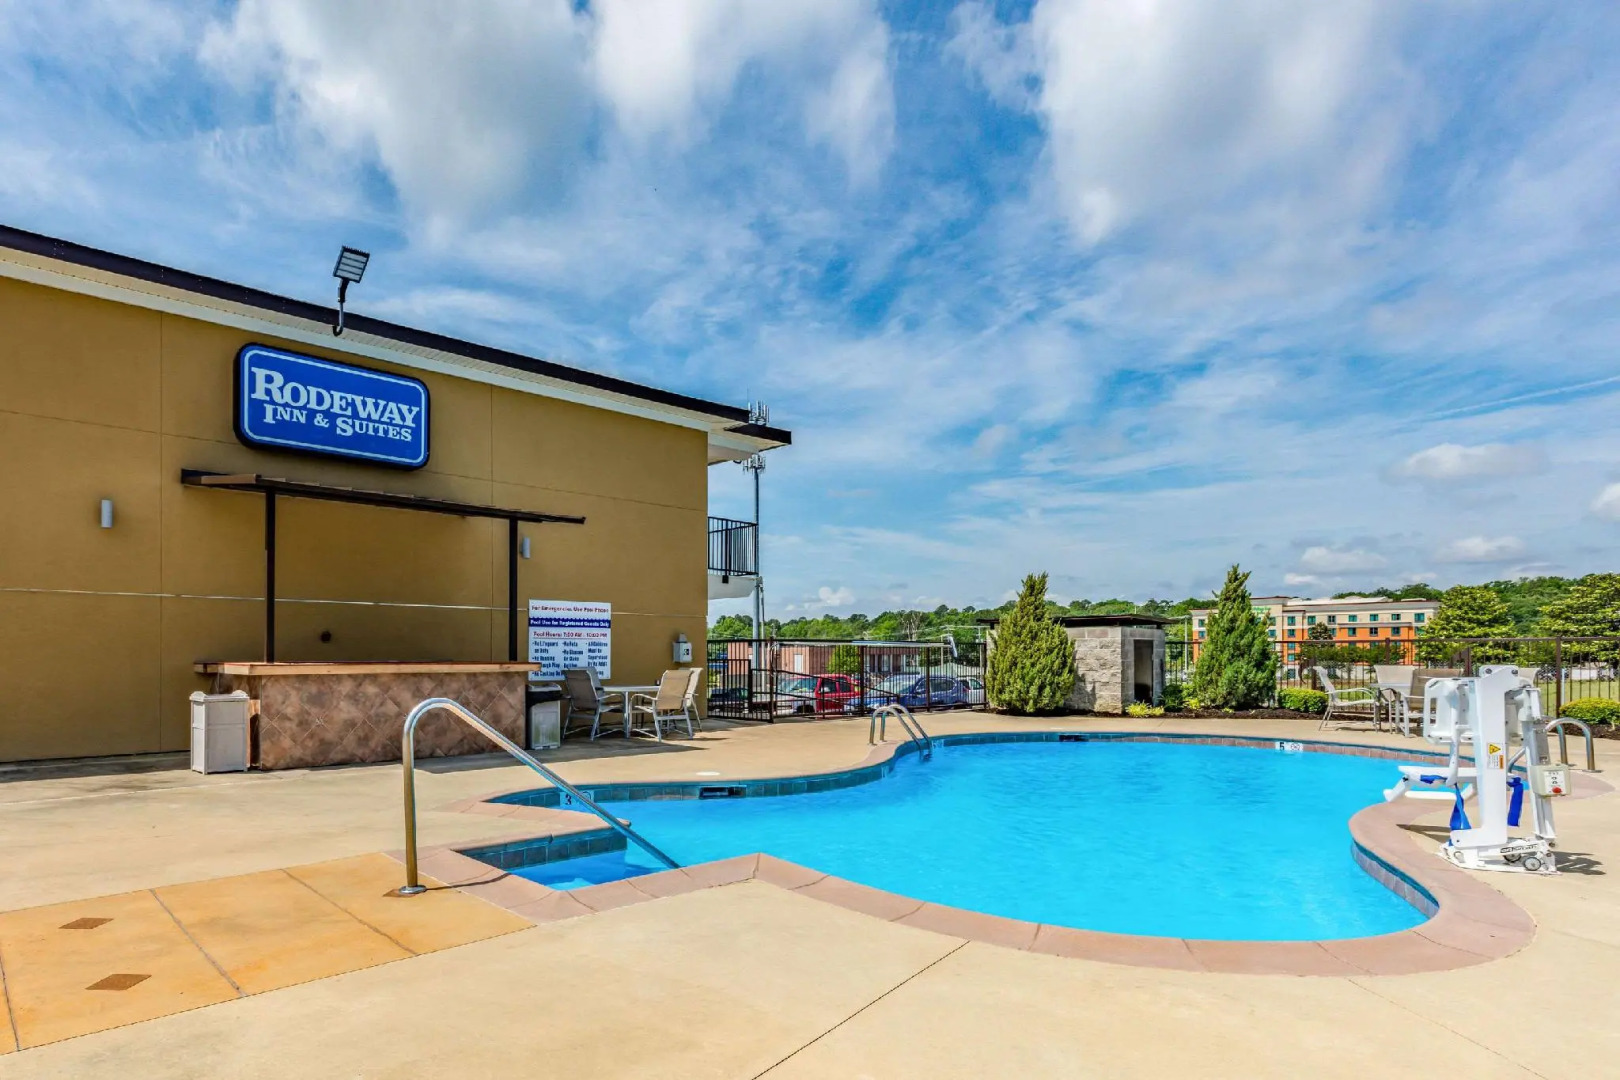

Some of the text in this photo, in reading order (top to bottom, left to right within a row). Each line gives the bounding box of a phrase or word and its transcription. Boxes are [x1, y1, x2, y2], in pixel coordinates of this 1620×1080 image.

[251, 367, 419, 427] RODEWAY
[264, 404, 412, 442] INN & SUITES
[1280, 742, 1284, 751] 5
[566, 794, 572, 805] 3
